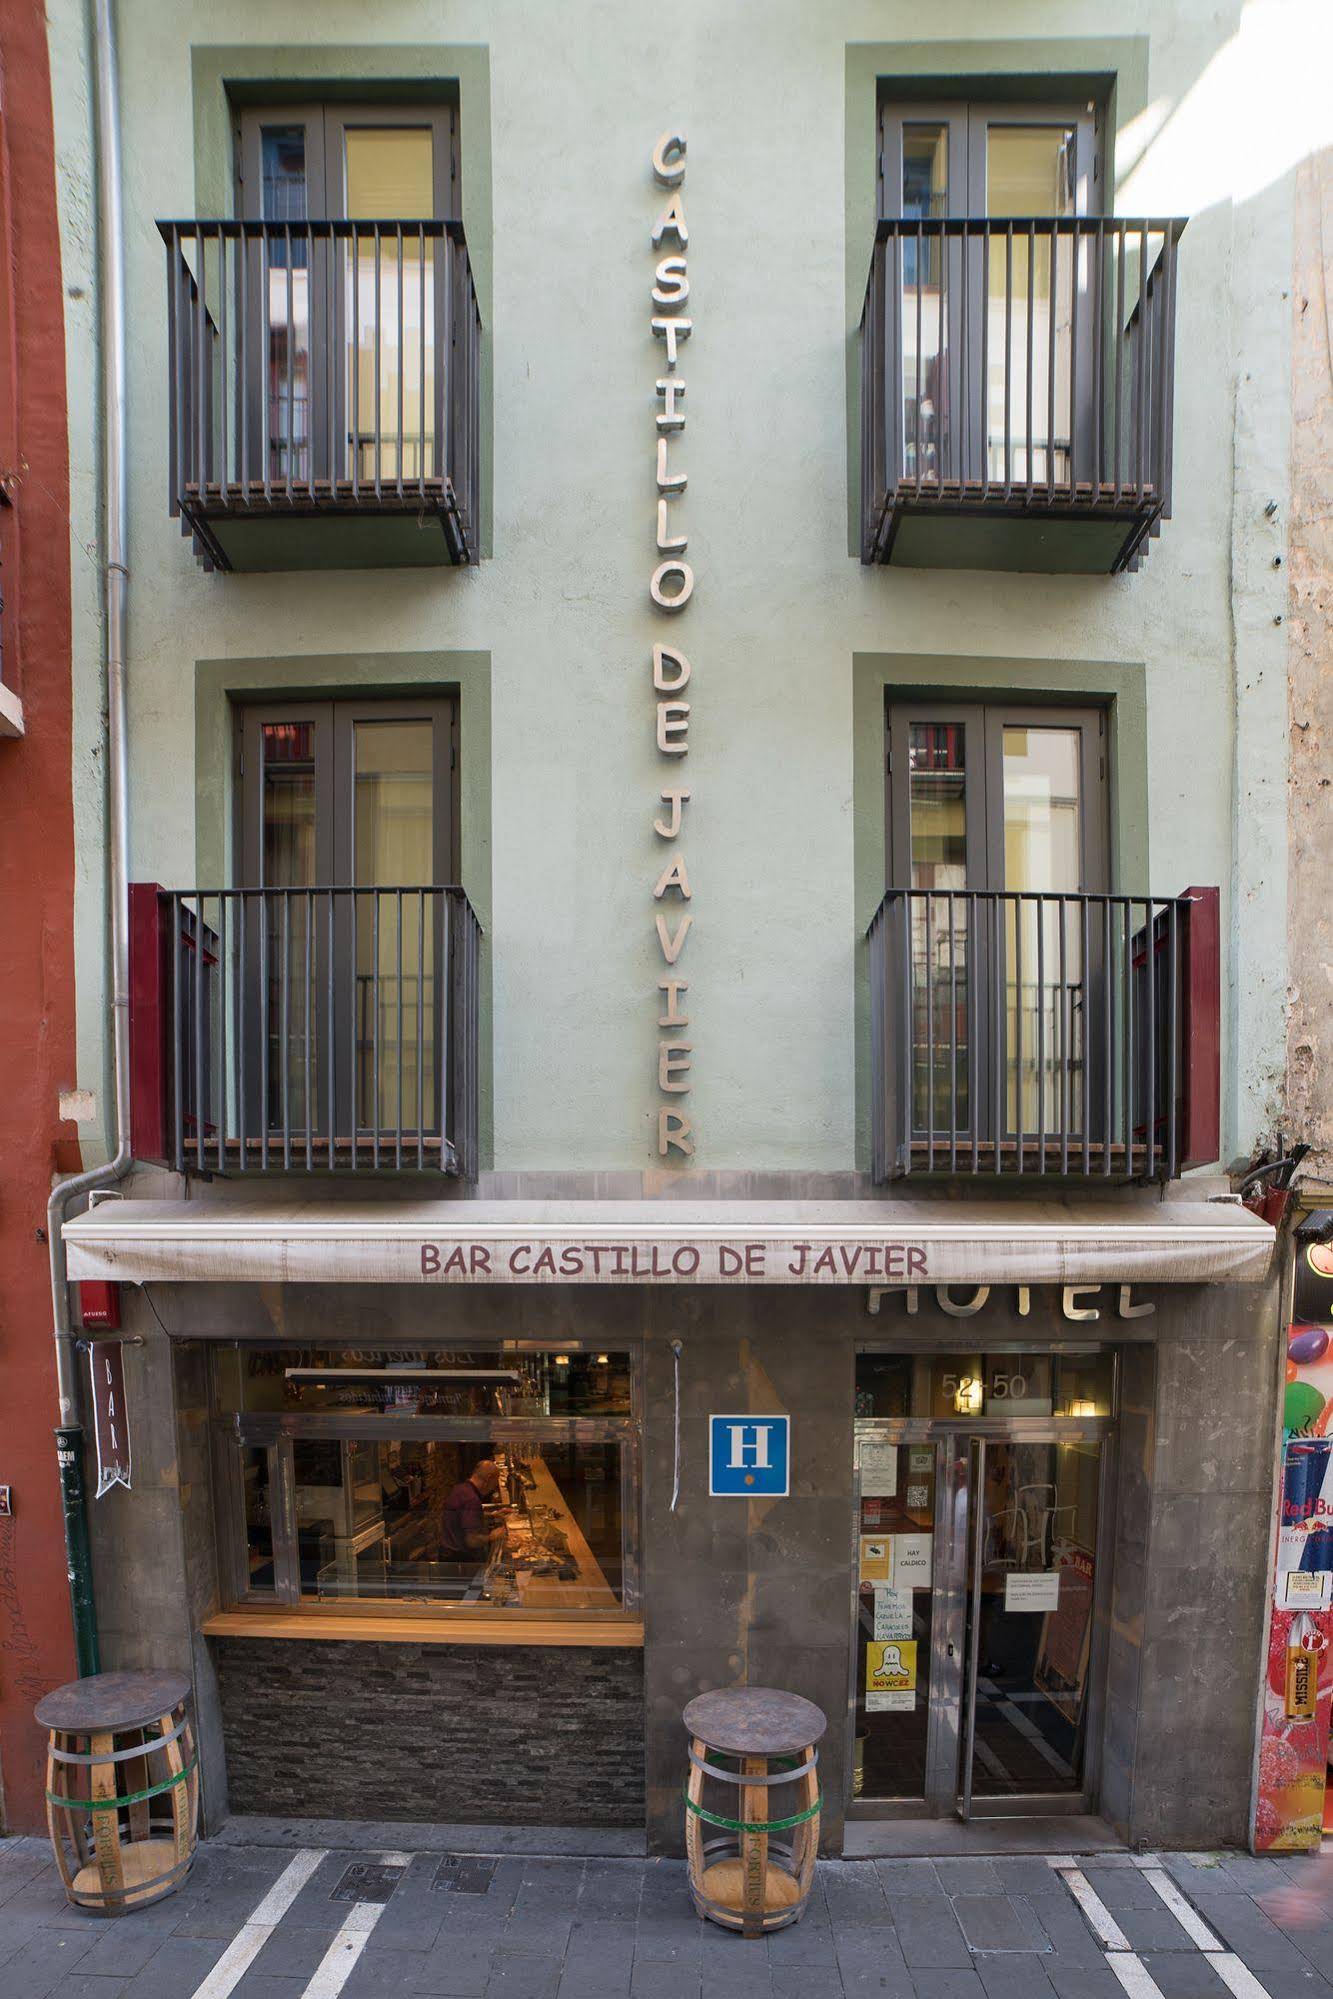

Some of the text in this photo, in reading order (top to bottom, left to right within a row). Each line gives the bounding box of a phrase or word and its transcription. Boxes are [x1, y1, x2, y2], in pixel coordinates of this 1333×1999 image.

[650, 130, 694, 1157] CASTILLO DE JAVIER
[421, 1244, 929, 1276] BAR CASTILLO DE JAVIER
[942, 1373, 1026, 1399] 52-50
[726, 1425, 774, 1469] H
[1284, 1497, 1313, 1518] Red
[900, 1559, 927, 1567] CALDICO
[748, 1837, 761, 1906] FORTIUS
